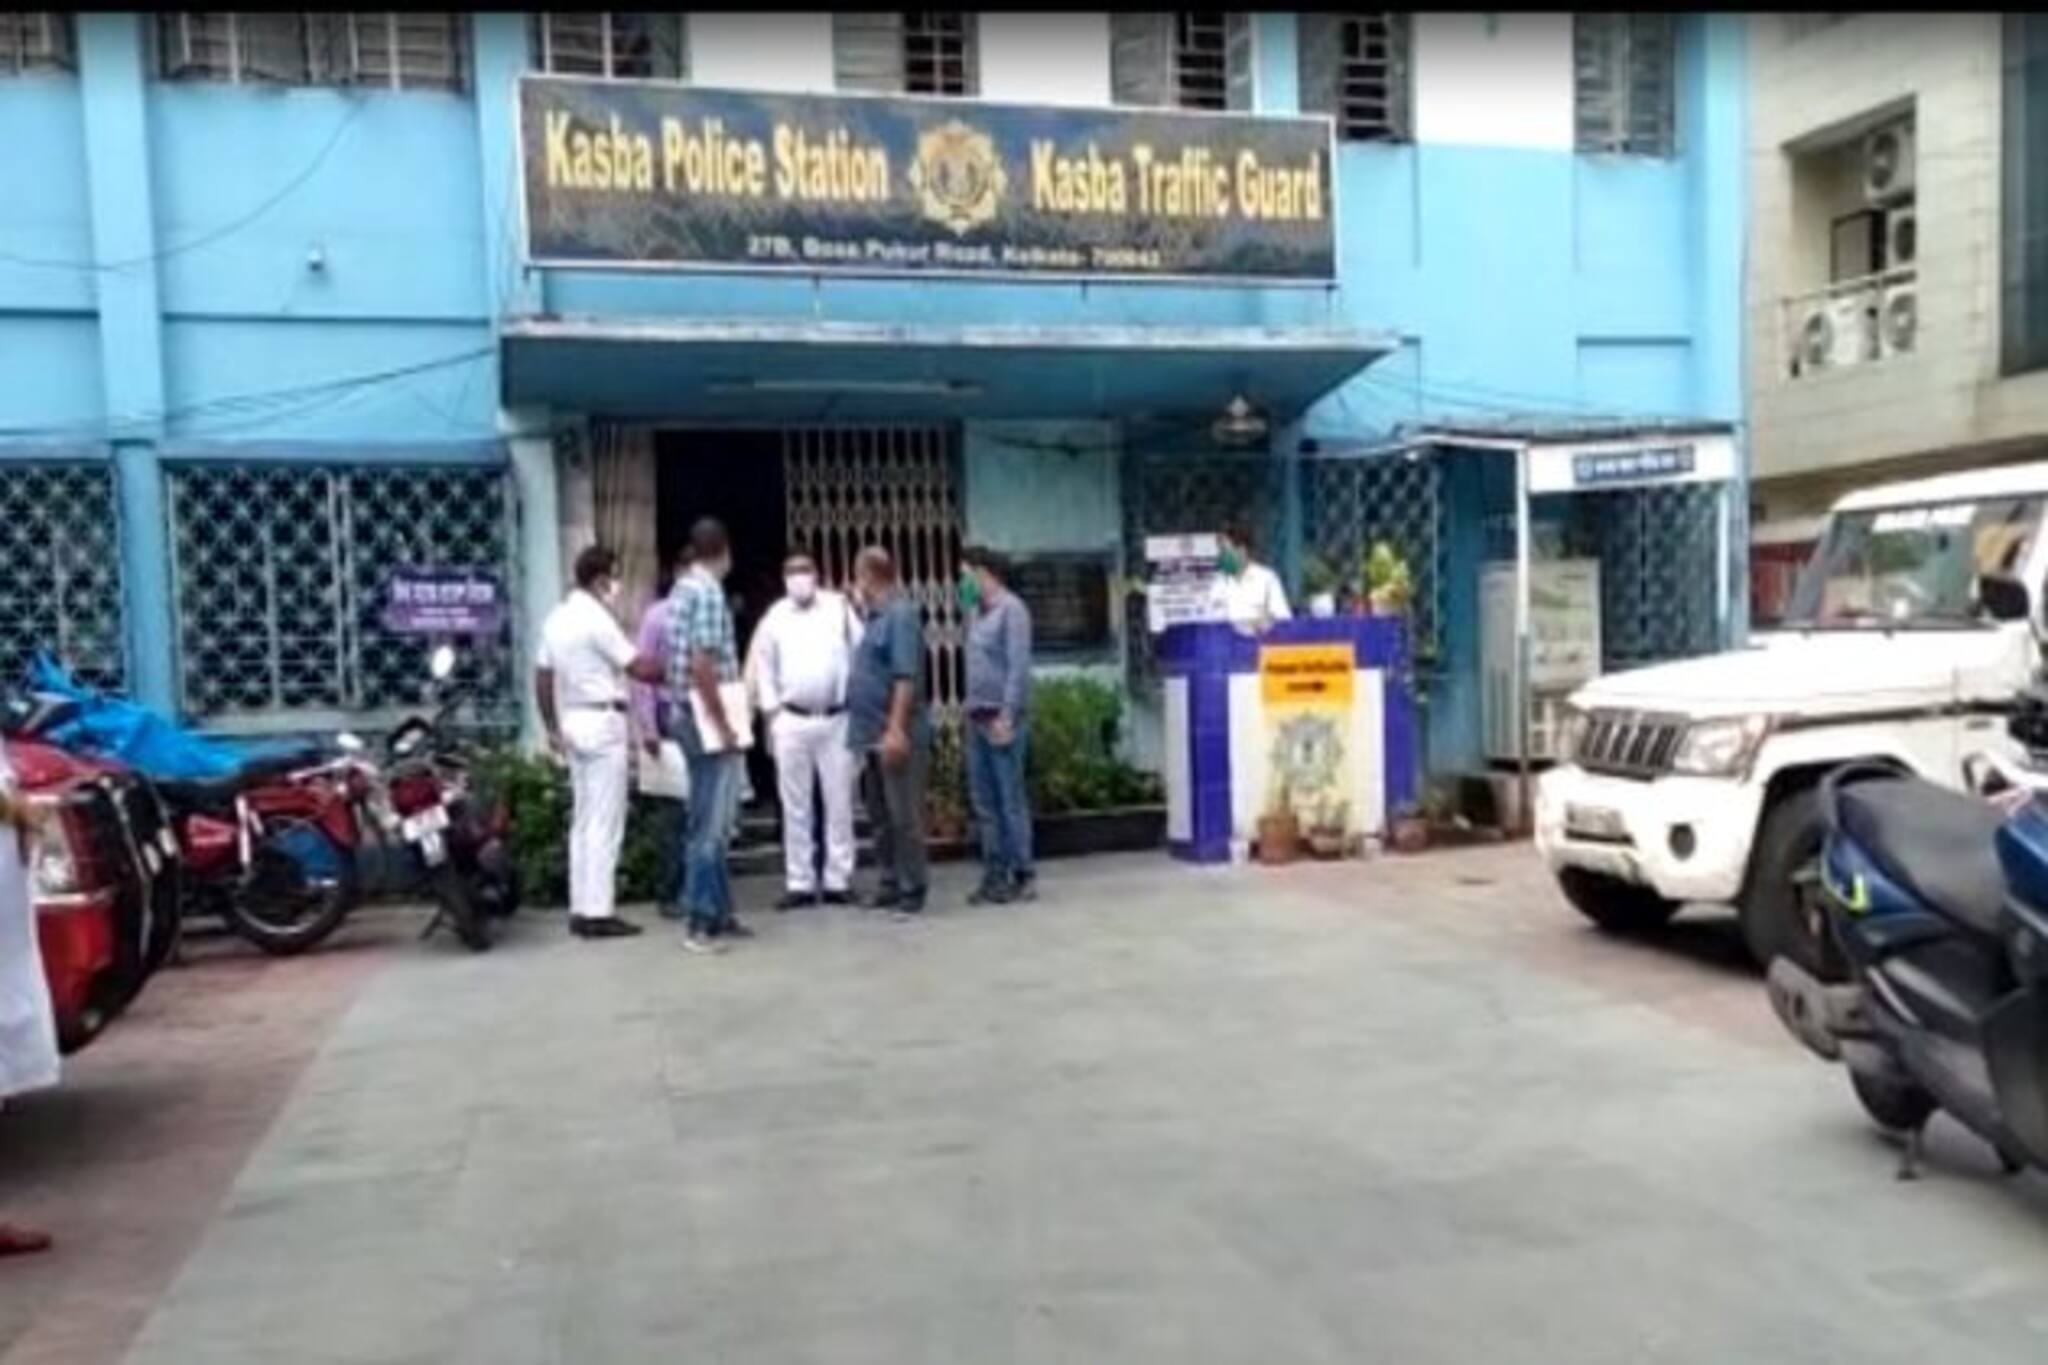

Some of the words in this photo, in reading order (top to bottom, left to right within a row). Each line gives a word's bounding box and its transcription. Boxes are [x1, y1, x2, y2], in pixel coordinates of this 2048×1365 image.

[545, 109, 653, 189] Kasba
[661, 115, 767, 195] Police
[773, 123, 890, 202] Station
[1030, 138, 1127, 214] Kasba
[1131, 142, 1229, 217] Traffic
[1235, 147, 1322, 220] Guard
